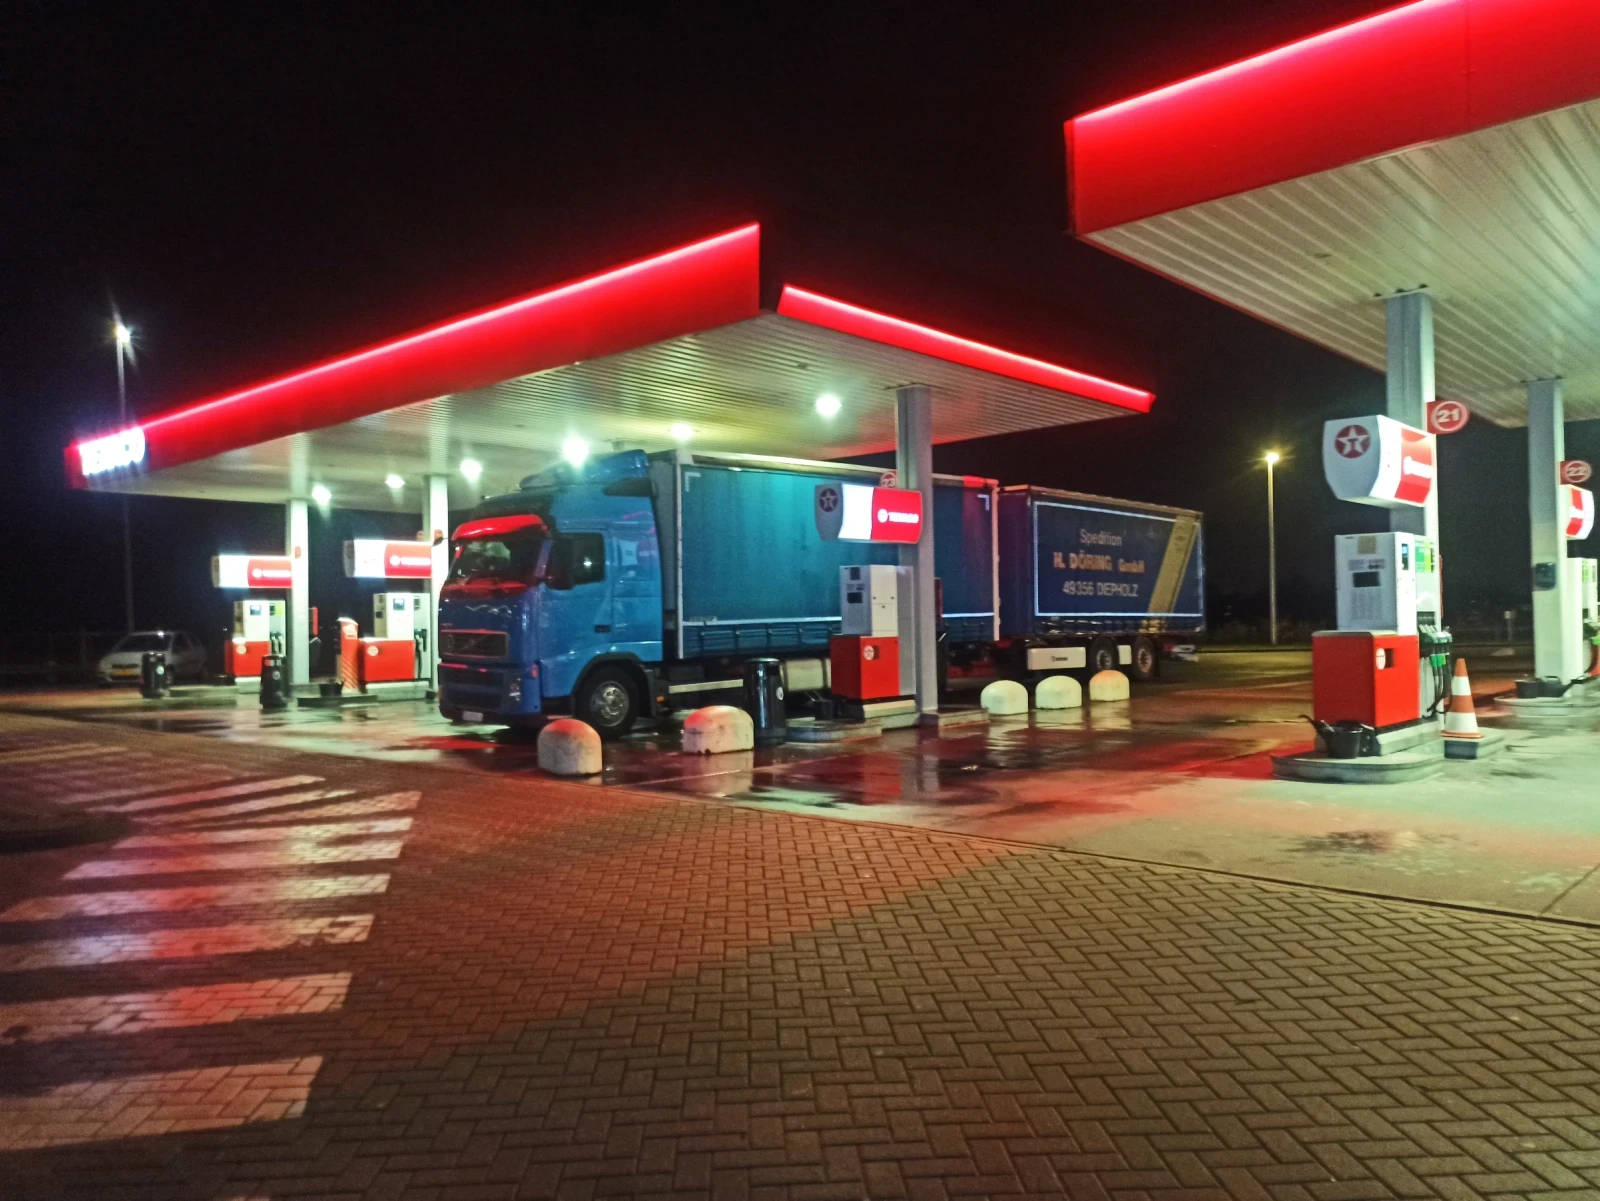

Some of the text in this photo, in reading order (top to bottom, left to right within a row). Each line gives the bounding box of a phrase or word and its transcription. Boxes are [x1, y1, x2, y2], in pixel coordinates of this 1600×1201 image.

[1436, 408, 1460, 424] 21
[1567, 465, 1587, 476] 22
[883, 477, 896, 487] 23
[1080, 529, 1122, 546] Spedition
[1069, 549, 1113, 571] DÖRING
[1119, 558, 1145, 573] GmbH
[1063, 581, 1139, 597] 49356 DIEPHOLZ
